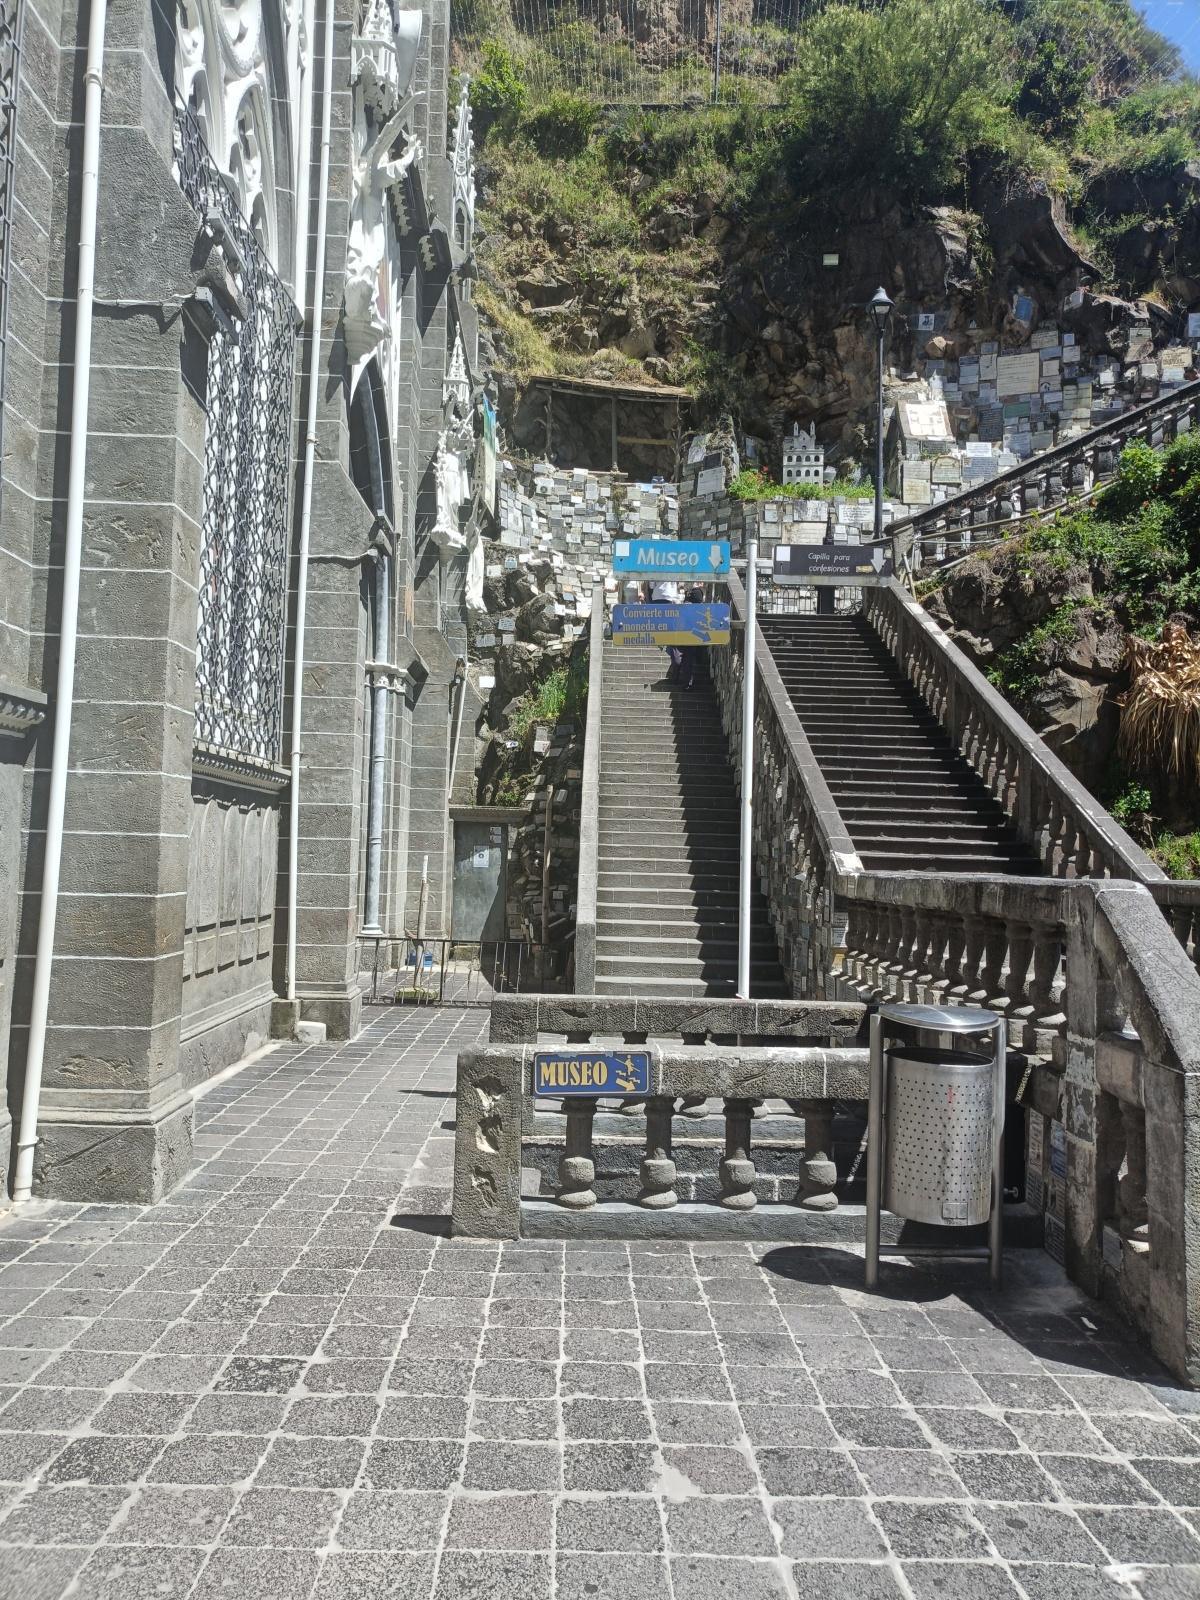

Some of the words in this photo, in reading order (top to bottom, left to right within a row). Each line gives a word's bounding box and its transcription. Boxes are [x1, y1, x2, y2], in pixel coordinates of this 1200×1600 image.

[636, 547, 699, 567] Museo
[808, 552, 830, 562] Capilla
[833, 554, 851, 563] para
[808, 564, 850, 574] confesiones
[623, 606, 663, 618] Convierte
[664, 609, 680, 618] una
[623, 620, 656, 631] moneda
[657, 622, 668, 631] en
[623, 632, 656, 645] medalla
[540, 1060, 608, 1087] MUSEO
